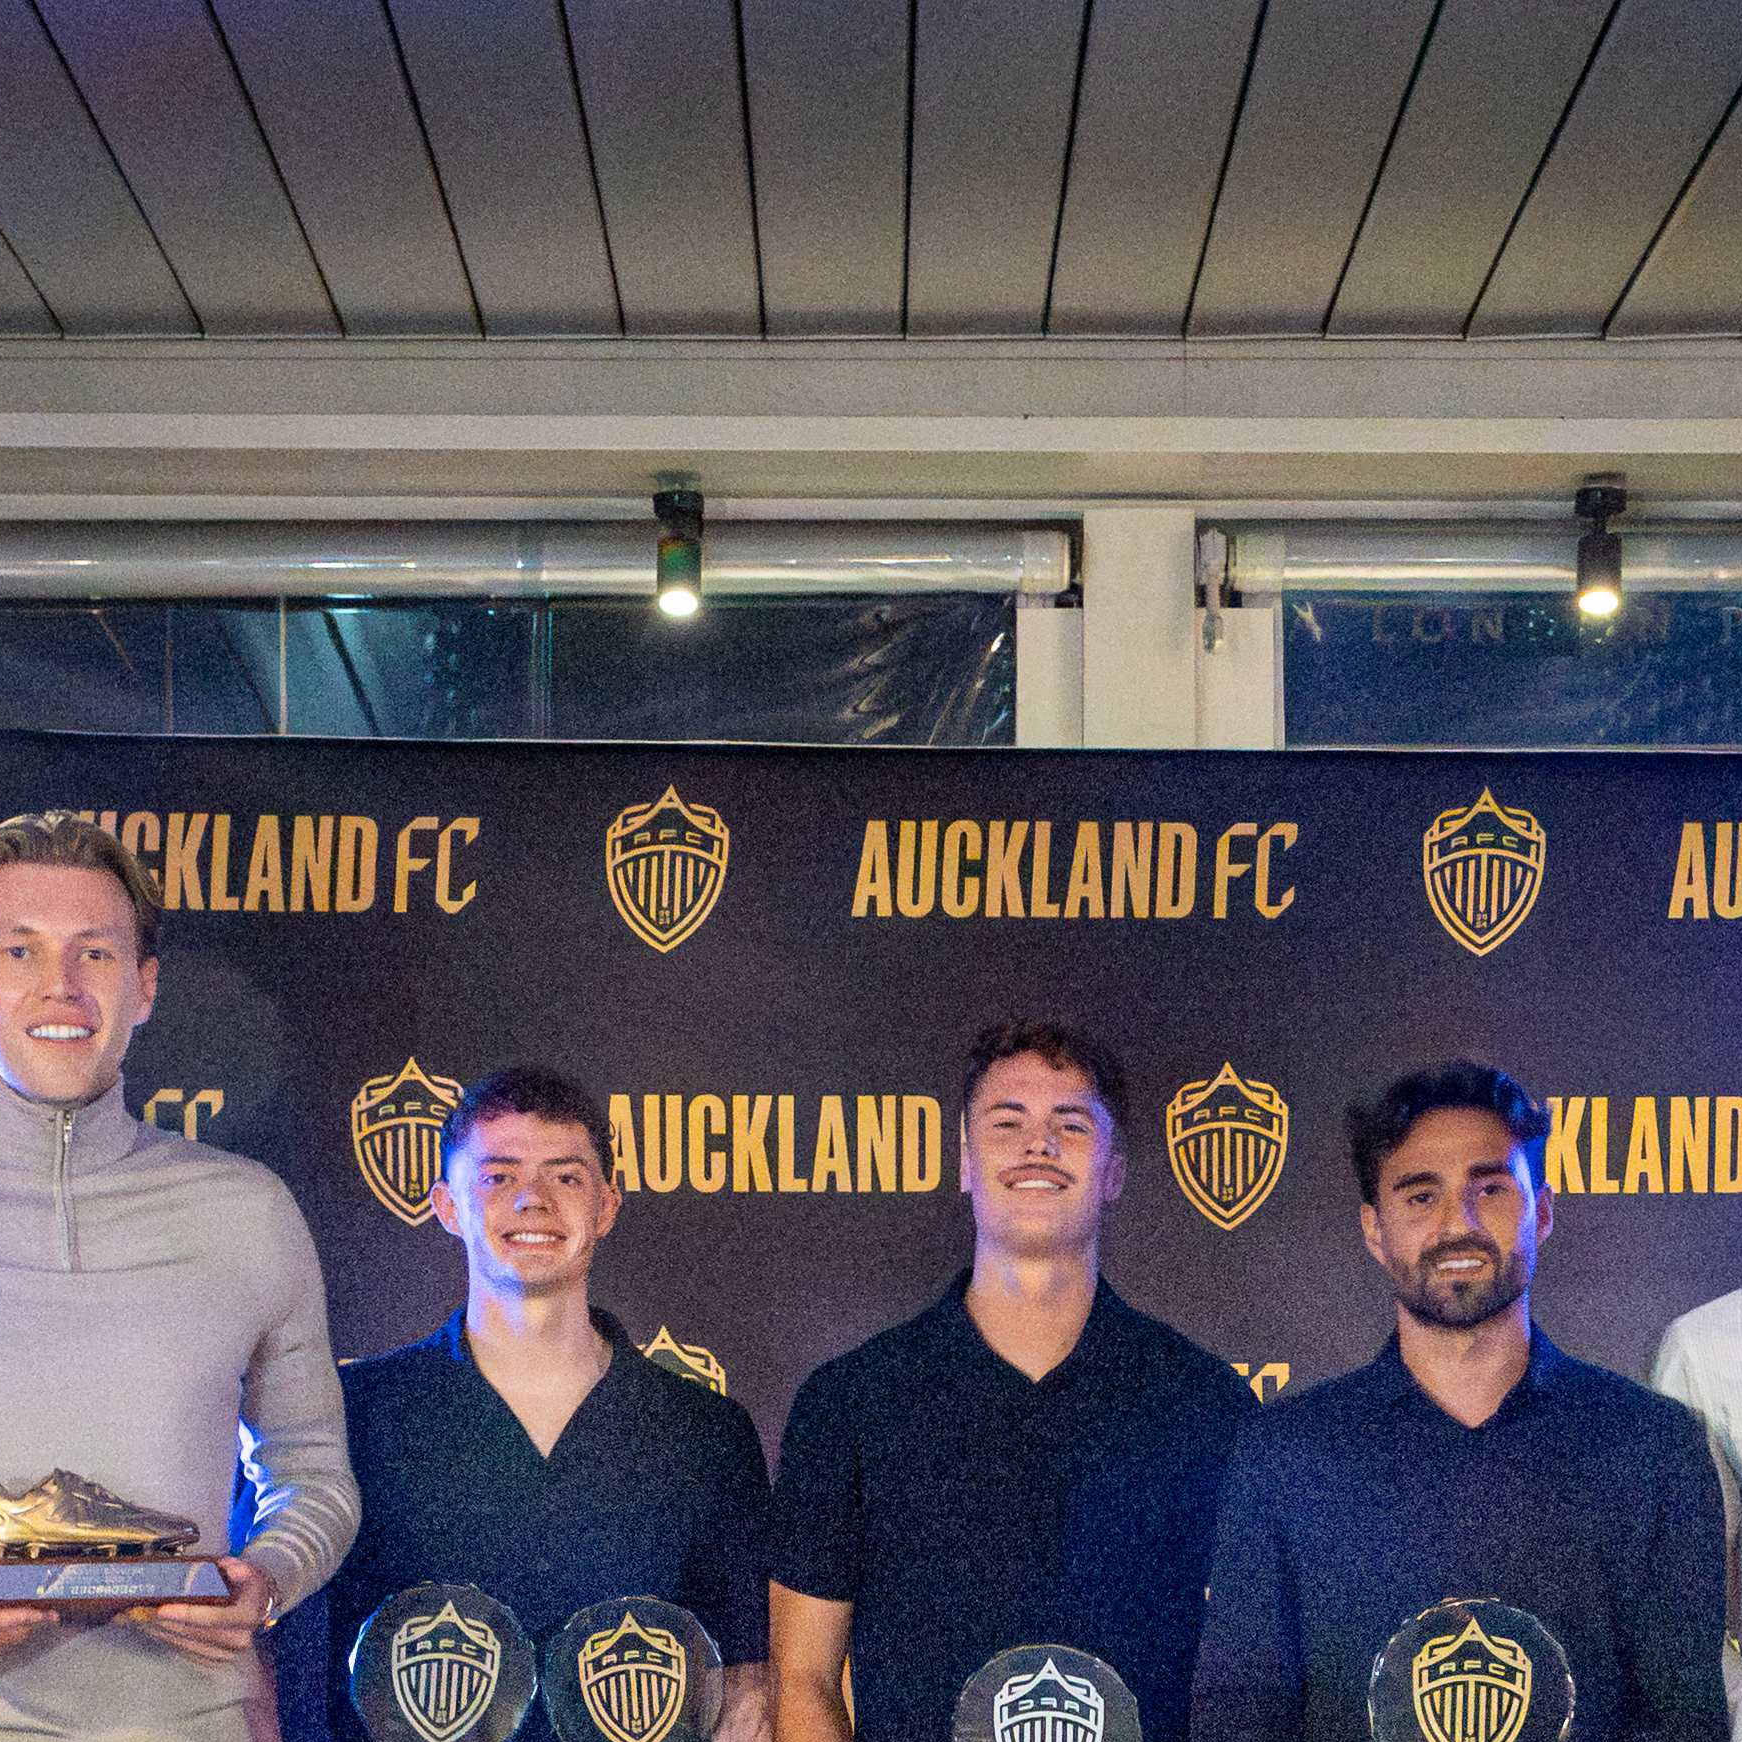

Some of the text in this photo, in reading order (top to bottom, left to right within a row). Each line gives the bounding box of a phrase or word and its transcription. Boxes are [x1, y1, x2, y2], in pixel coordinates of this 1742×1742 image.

[79, 810, 480, 914] CKLAND FC
[851, 820, 1299, 919] AUCKLAND FC
[609, 1094, 942, 1193] AUCKLAND
